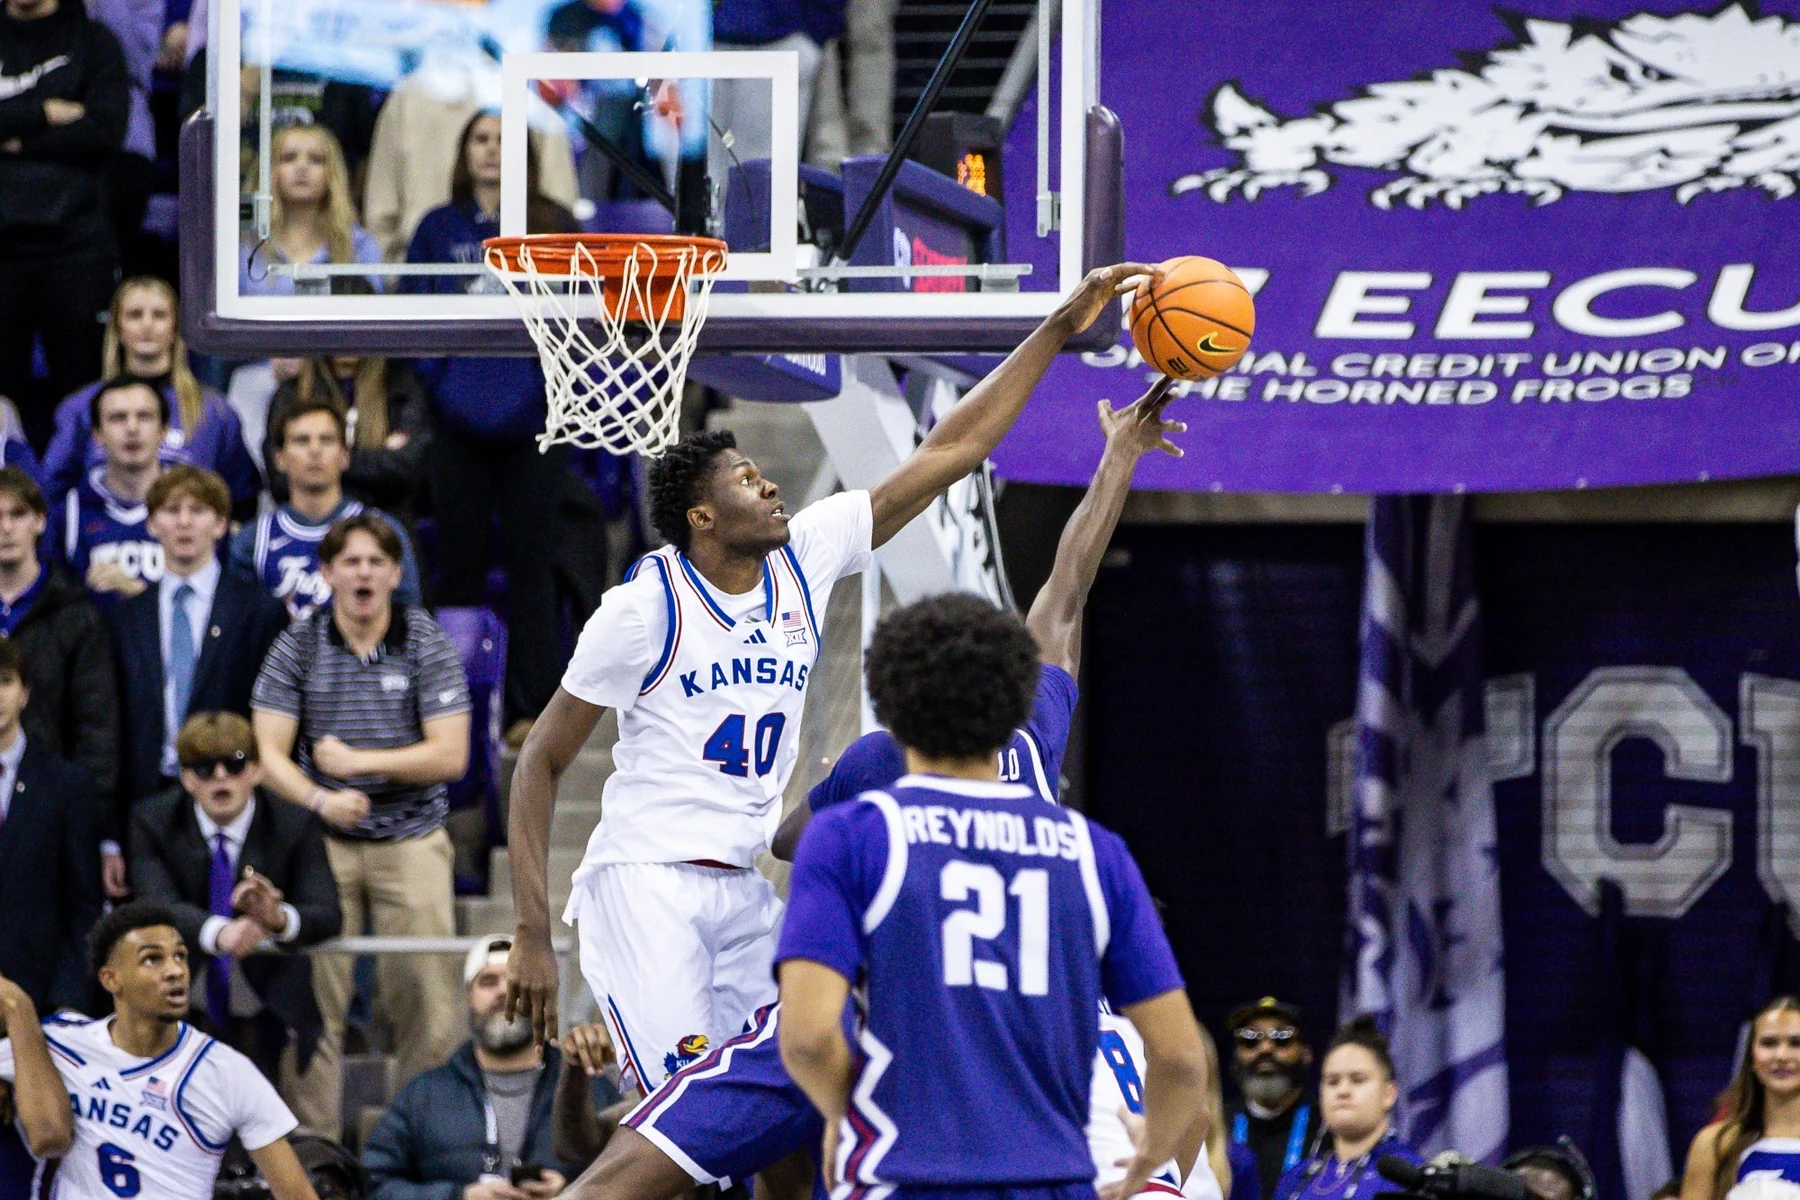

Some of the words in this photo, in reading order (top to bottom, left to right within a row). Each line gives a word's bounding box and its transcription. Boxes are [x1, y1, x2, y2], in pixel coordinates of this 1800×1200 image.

[1314, 263, 1800, 339] EECU
[1081, 344, 1318, 377] OIAL
[1331, 352, 1534, 378] CREDIT
[1542, 345, 1727, 378] UNION
[1262, 378, 1498, 405] HORNED
[1511, 373, 1694, 403] FROGS
[680, 658, 808, 698] KANSAS
[703, 712, 786, 778] 40
[900, 805, 1080, 861] REYNOLDS
[940, 859, 1049, 996] 21
[69, 1093, 180, 1151] ANSAS
[96, 1142, 141, 1198] 6
